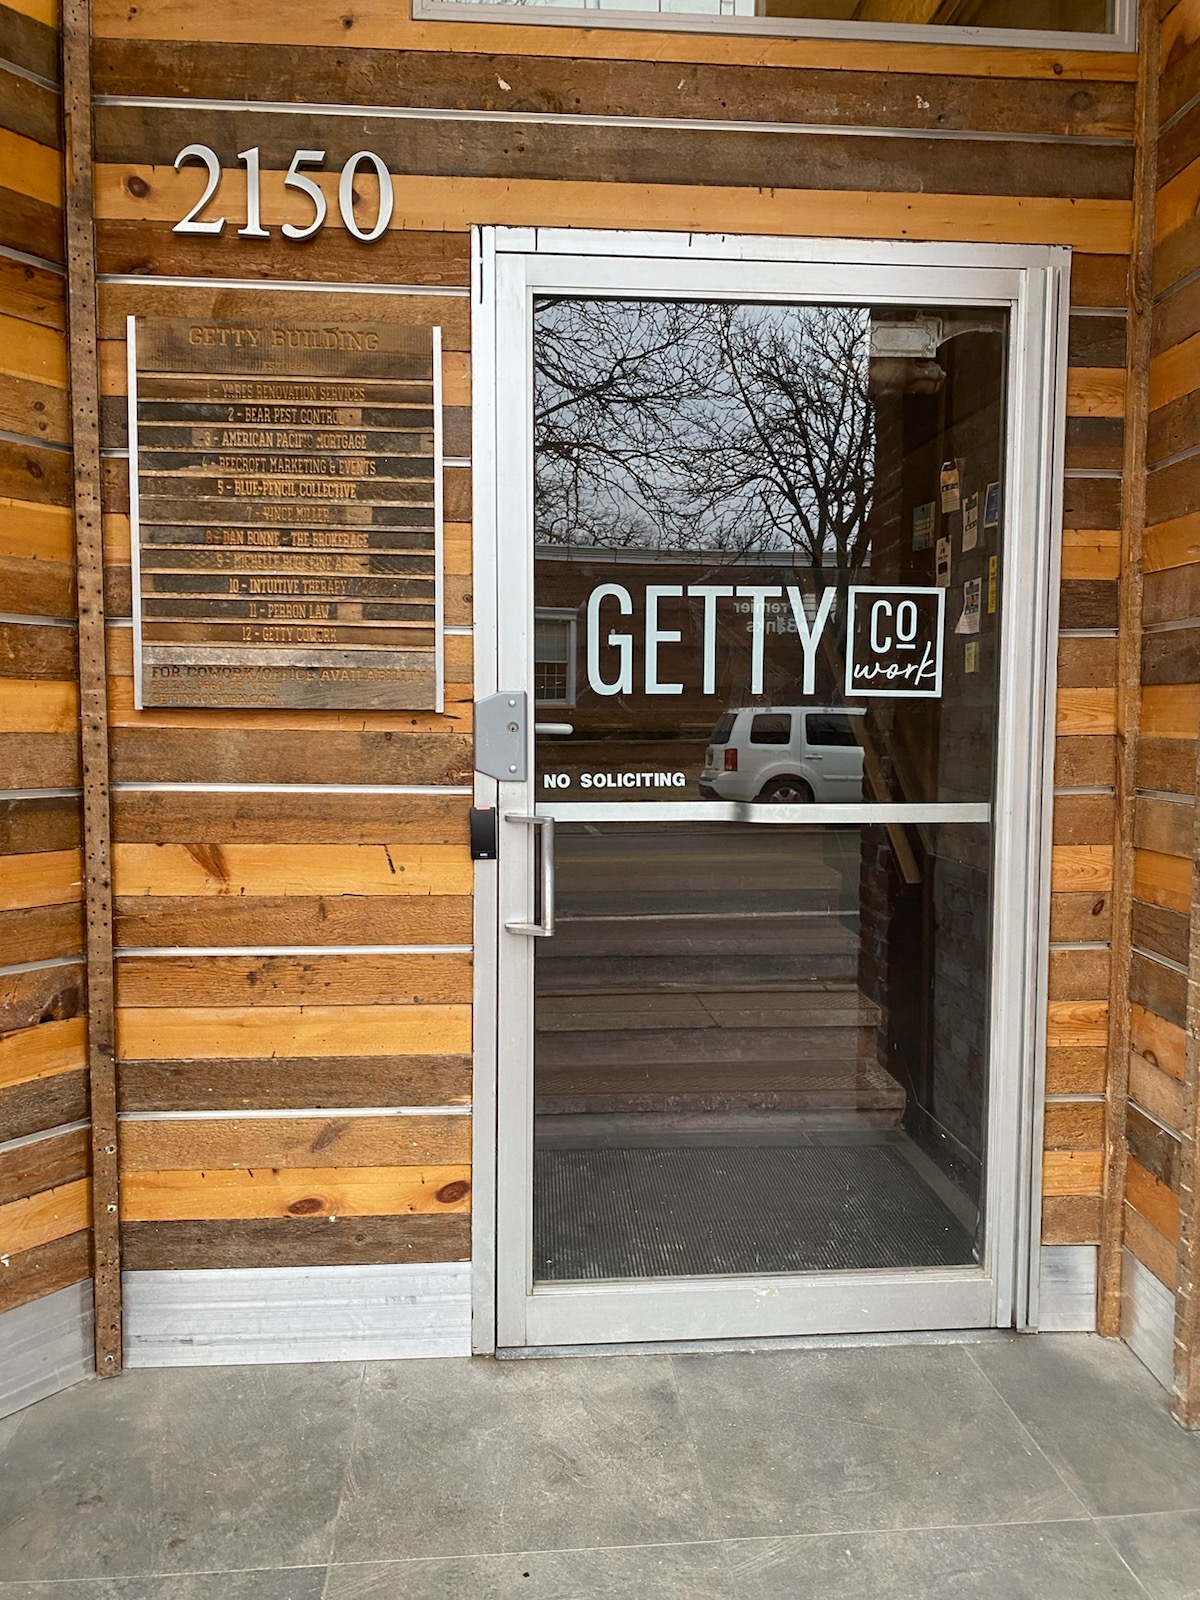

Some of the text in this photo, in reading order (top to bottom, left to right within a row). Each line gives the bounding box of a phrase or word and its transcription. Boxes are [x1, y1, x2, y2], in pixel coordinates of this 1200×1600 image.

[172, 143, 395, 242] 2150
[188, 325, 380, 351] GETTY BUILDING
[257, 384, 317, 400] RENOVATION
[320, 386, 365, 401] SERVICES
[228, 407, 234, 422] 2
[245, 407, 271, 423] BEAR
[274, 408, 298, 423] PEST
[301, 408, 344, 425] CONTROL
[222, 432, 273, 447] AMERICAN
[276, 433, 313, 448] PACIFIC
[317, 434, 367, 449] MORTGAGE
[219, 456, 266, 472] BEECROFT
[270, 457, 326, 474] MARKETING
[329, 459, 336, 473] &
[339, 458, 377, 475] EVENTS
[217, 480, 223, 494] 5
[299, 481, 357, 499] COLLECTIVE
[296, 507, 331, 522] MILLER
[223, 530, 244, 545] DAN
[290, 531, 311, 547] THE
[312, 532, 370, 548] BROKERAGE
[229, 578, 239, 593] 10
[250, 578, 299, 594] INTUITIVE
[302, 579, 347, 595] THERAPY
[250, 604, 256, 618] 11
[268, 603, 306, 619] PERRON
[309, 604, 330, 619] LAW
[242, 627, 251, 641] 12
[262, 627, 293, 642] GETTY
[297, 628, 337, 642] COWORK
[870, 599, 918, 654] CO
[586, 583, 837, 696] GETTY
[854, 640, 937, 686] work
[152, 666, 181, 678] FOR
[320, 668, 426, 682] AVAILABILITY
[543, 772, 686, 788] NO SOLICITING
